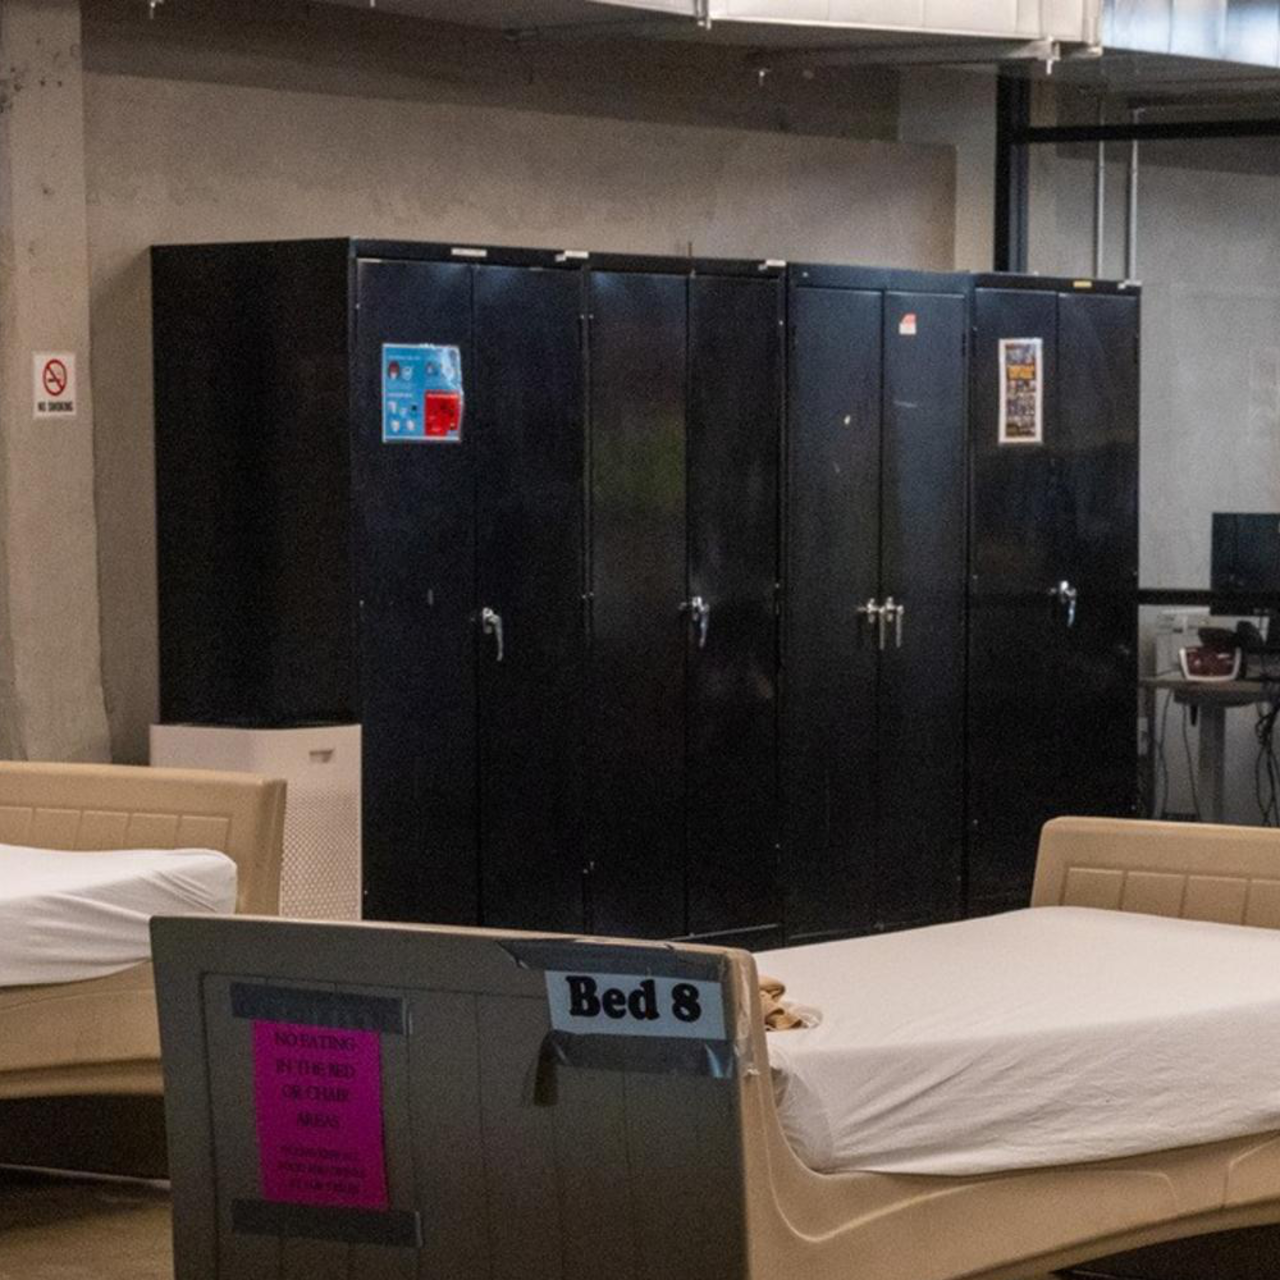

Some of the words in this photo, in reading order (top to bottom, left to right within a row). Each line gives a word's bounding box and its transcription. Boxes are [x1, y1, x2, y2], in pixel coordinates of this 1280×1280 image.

[565, 975, 660, 1020] Bed
[672, 983, 701, 1023] 8
[275, 1032, 298, 1046] NO
[299, 1034, 356, 1051] EATING
[275, 1058, 291, 1075] IN
[296, 1060, 326, 1077] THE
